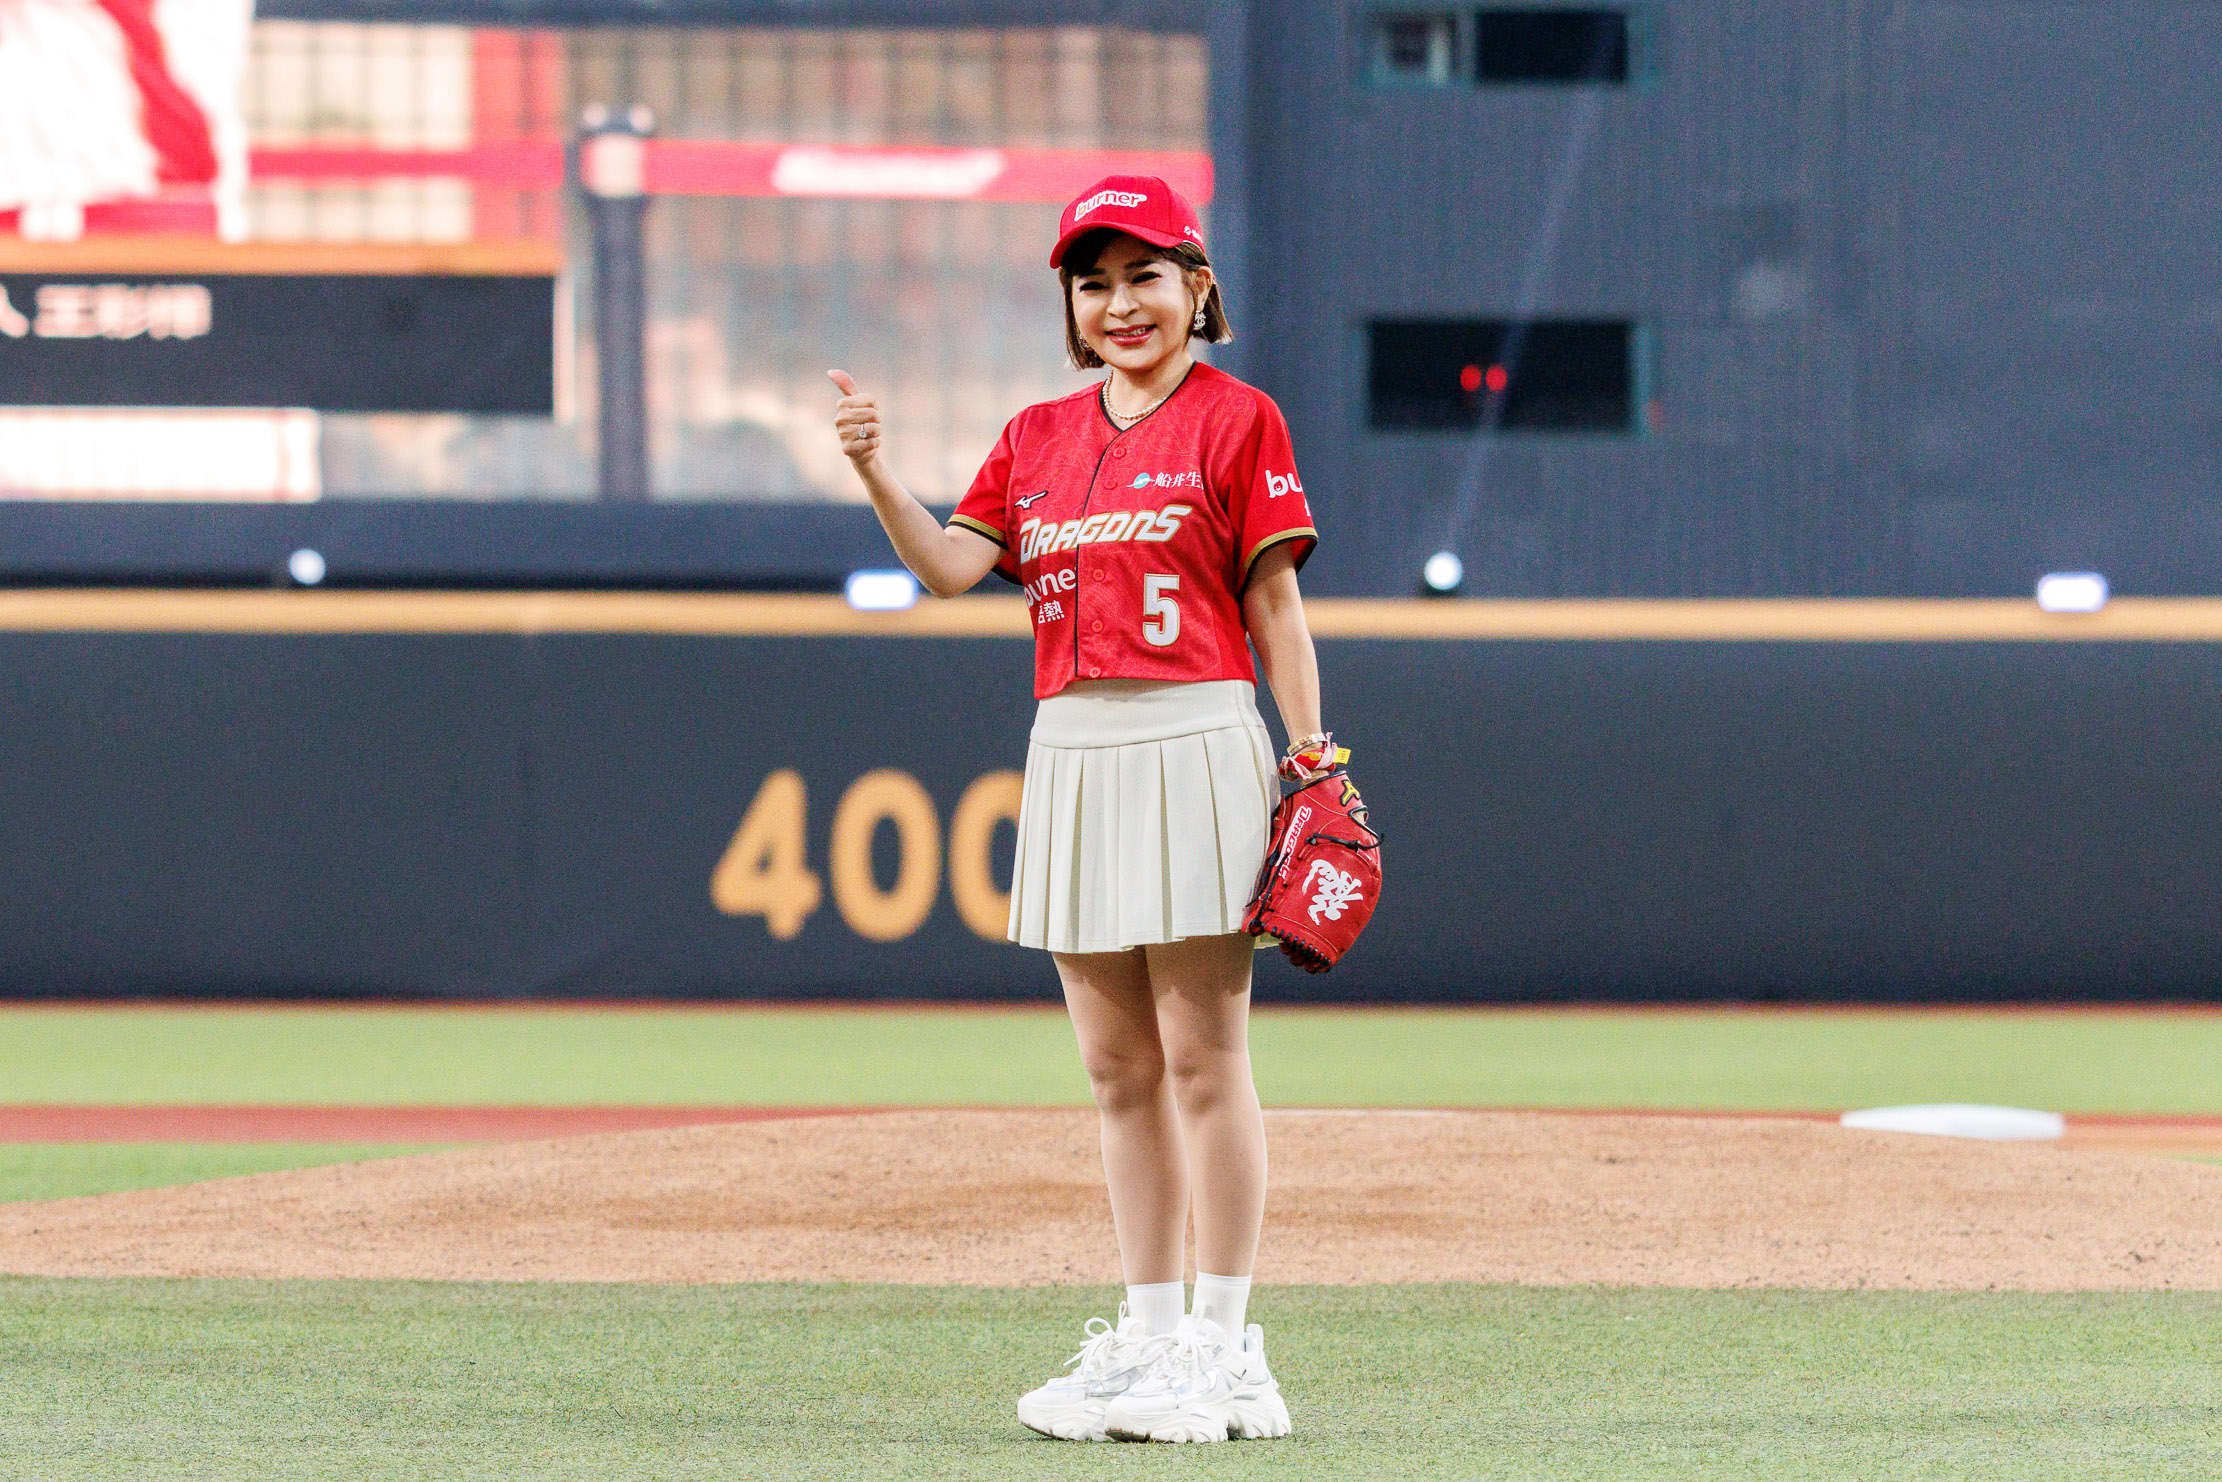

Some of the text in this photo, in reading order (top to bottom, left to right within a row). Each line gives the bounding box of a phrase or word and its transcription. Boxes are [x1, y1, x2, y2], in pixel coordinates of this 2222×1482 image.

[1074, 190, 1147, 221] burner
[1153, 471, 1204, 490] 船井生
[1020, 504, 1193, 564] DRAGONS
[1142, 573, 1180, 647] 5
[709, 767, 1026, 943] 400
